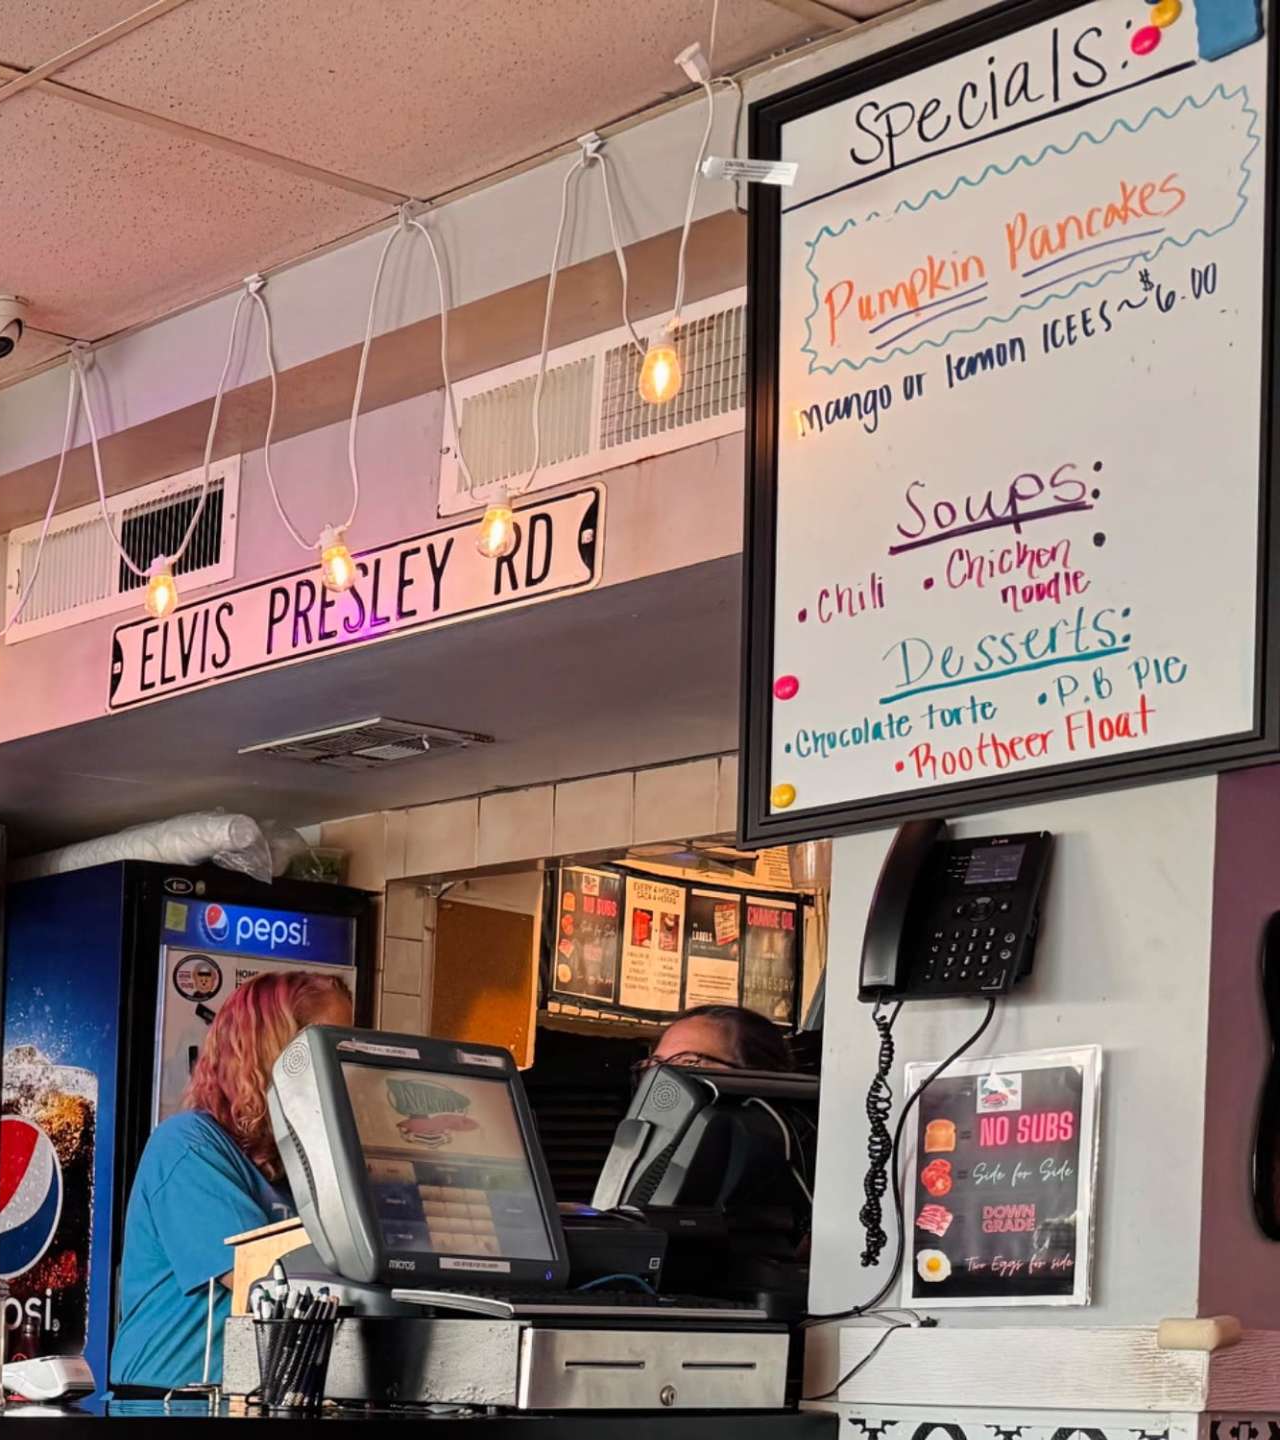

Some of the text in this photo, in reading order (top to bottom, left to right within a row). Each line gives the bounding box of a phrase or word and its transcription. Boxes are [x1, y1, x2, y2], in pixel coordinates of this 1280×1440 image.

[850, 20, 1133, 168] Specials:
[825, 173, 1186, 346] Pumpkin Pancakes
[797, 384, 892, 436] mango
[903, 372, 925, 402] or
[946, 336, 1025, 388] lemon
[897, 460, 1103, 538] Soups:
[139, 511, 554, 692] ELVIS PRESLEY RD
[818, 539, 1071, 623] Chili Chicken
[1001, 568, 1091, 612] noodle
[883, 607, 1132, 688] Desserts:
[795, 709, 912, 759] Chocolate
[909, 694, 1157, 780] Rootbeer Float
[236, 917, 309, 949] pepsi
[980, 1111, 1073, 1146] NO SUBS
[973, 1157, 1073, 1187] Side for Side
[982, 1218, 1036, 1233] GRADE
[983, 1204, 1036, 1219] DOWN
[389, 1260, 416, 1271] micros
[965, 1253, 1074, 1276] Two Eggs for side
